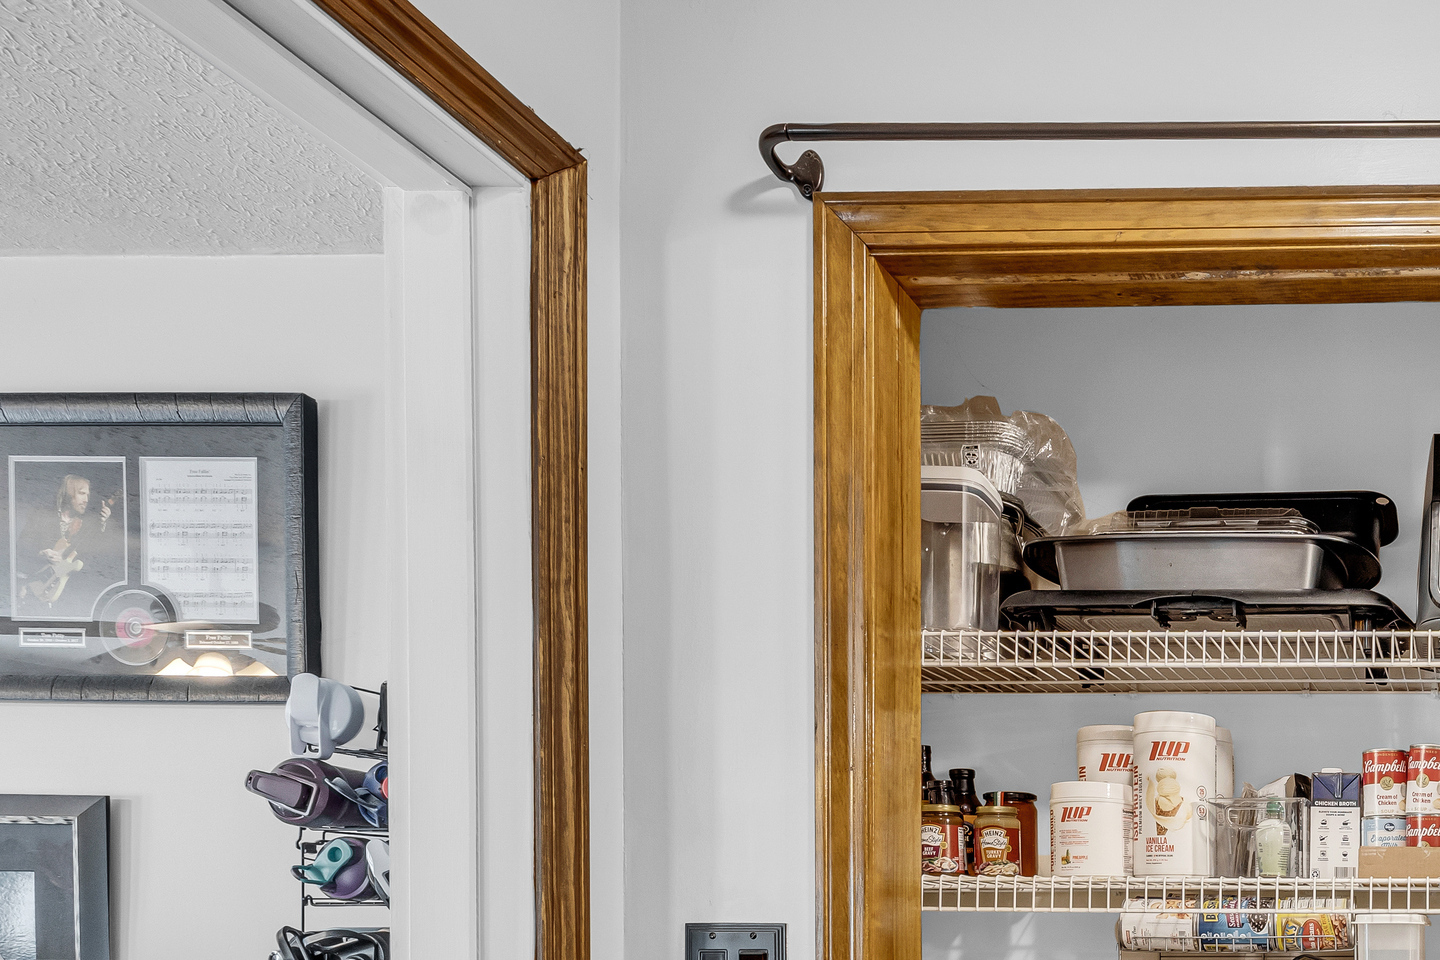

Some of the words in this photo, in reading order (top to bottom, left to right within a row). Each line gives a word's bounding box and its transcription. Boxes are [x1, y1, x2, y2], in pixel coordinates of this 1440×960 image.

[1148, 740, 1190, 761] 1UP
[1060, 805, 1093, 823] 1UP
[984, 830, 1003, 838] HEINZ
[1145, 836, 1168, 845] VANILLA
[1145, 845, 1153, 853] ICE
[1154, 844, 1175, 853] CREAM
